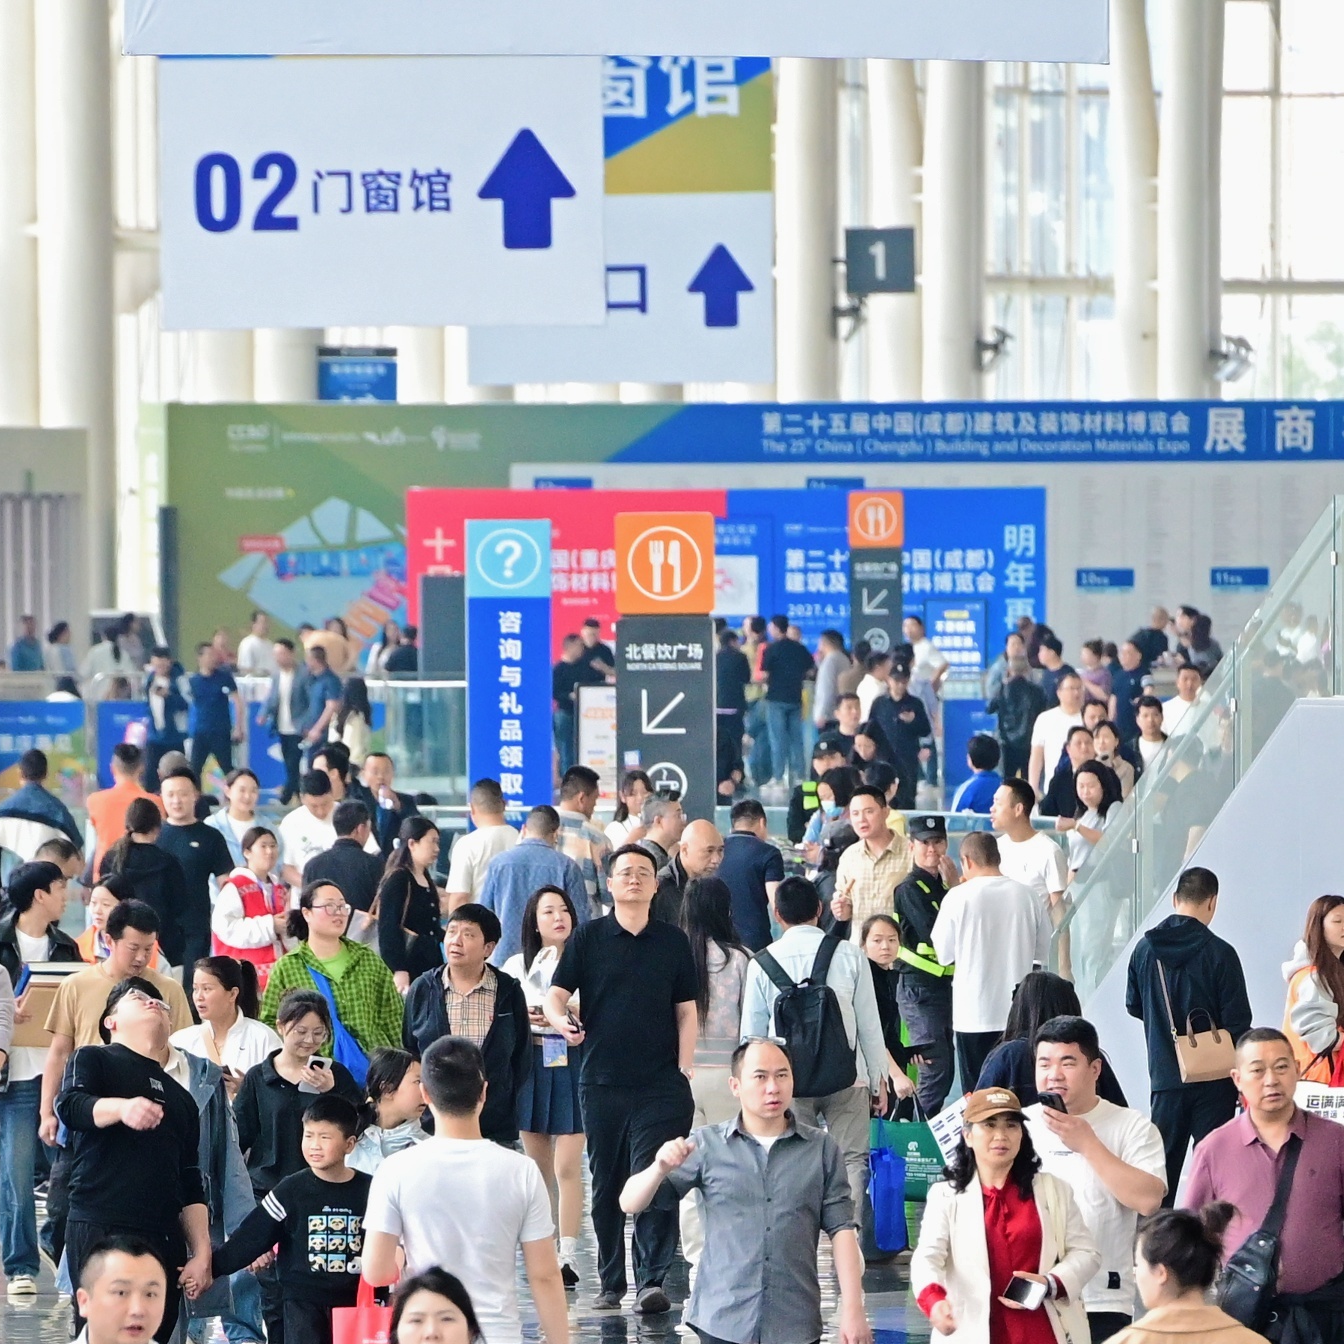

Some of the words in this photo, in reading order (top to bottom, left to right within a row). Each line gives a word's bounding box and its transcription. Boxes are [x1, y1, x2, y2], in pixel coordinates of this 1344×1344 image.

[195, 152, 298, 231] 02
[313, 169, 451, 213] 门窗馆
[868, 241, 888, 281] 1
[762, 438, 786, 454] The
[815, 438, 854, 454] China
[935, 438, 990, 456] Building
[993, 438, 1017, 453] and
[1021, 438, 1092, 454] Decoration
[1095, 439, 1156, 454] Materials
[1158, 439, 1190, 456] Expo
[625, 643, 704, 661] 北餐饮广场
